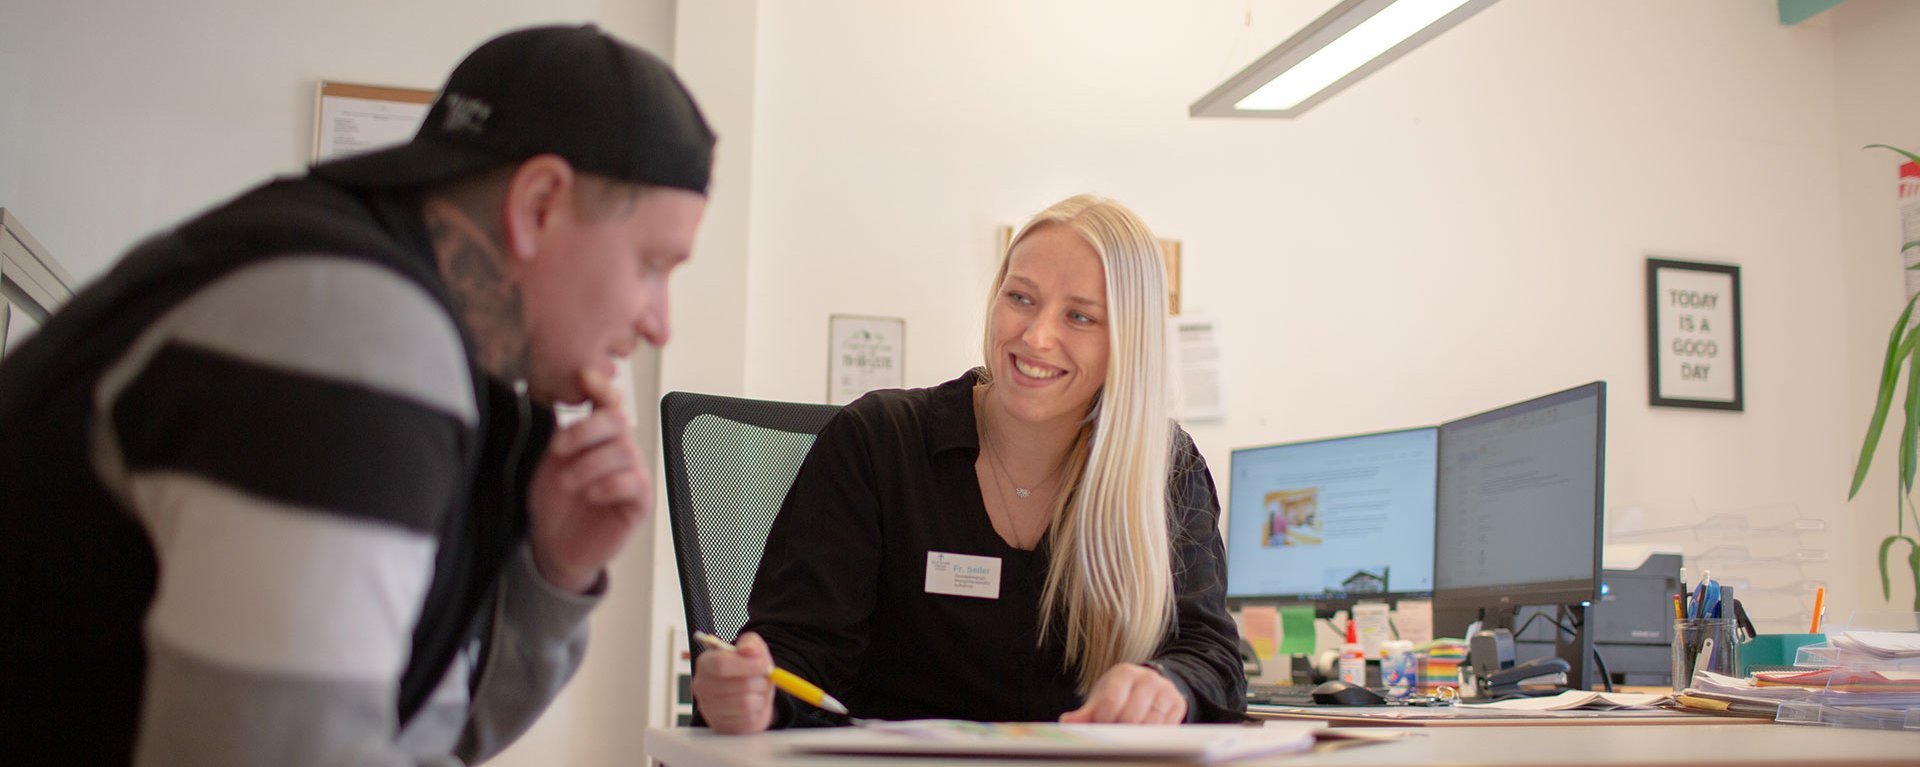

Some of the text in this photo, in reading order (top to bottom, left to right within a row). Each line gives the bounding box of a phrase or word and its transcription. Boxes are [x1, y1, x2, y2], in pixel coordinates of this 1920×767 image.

[1668, 289, 1719, 309] TODAY
[1679, 315, 1710, 332] IS A
[1672, 338, 1718, 358] GOOD
[1681, 363, 1710, 380] DAY
